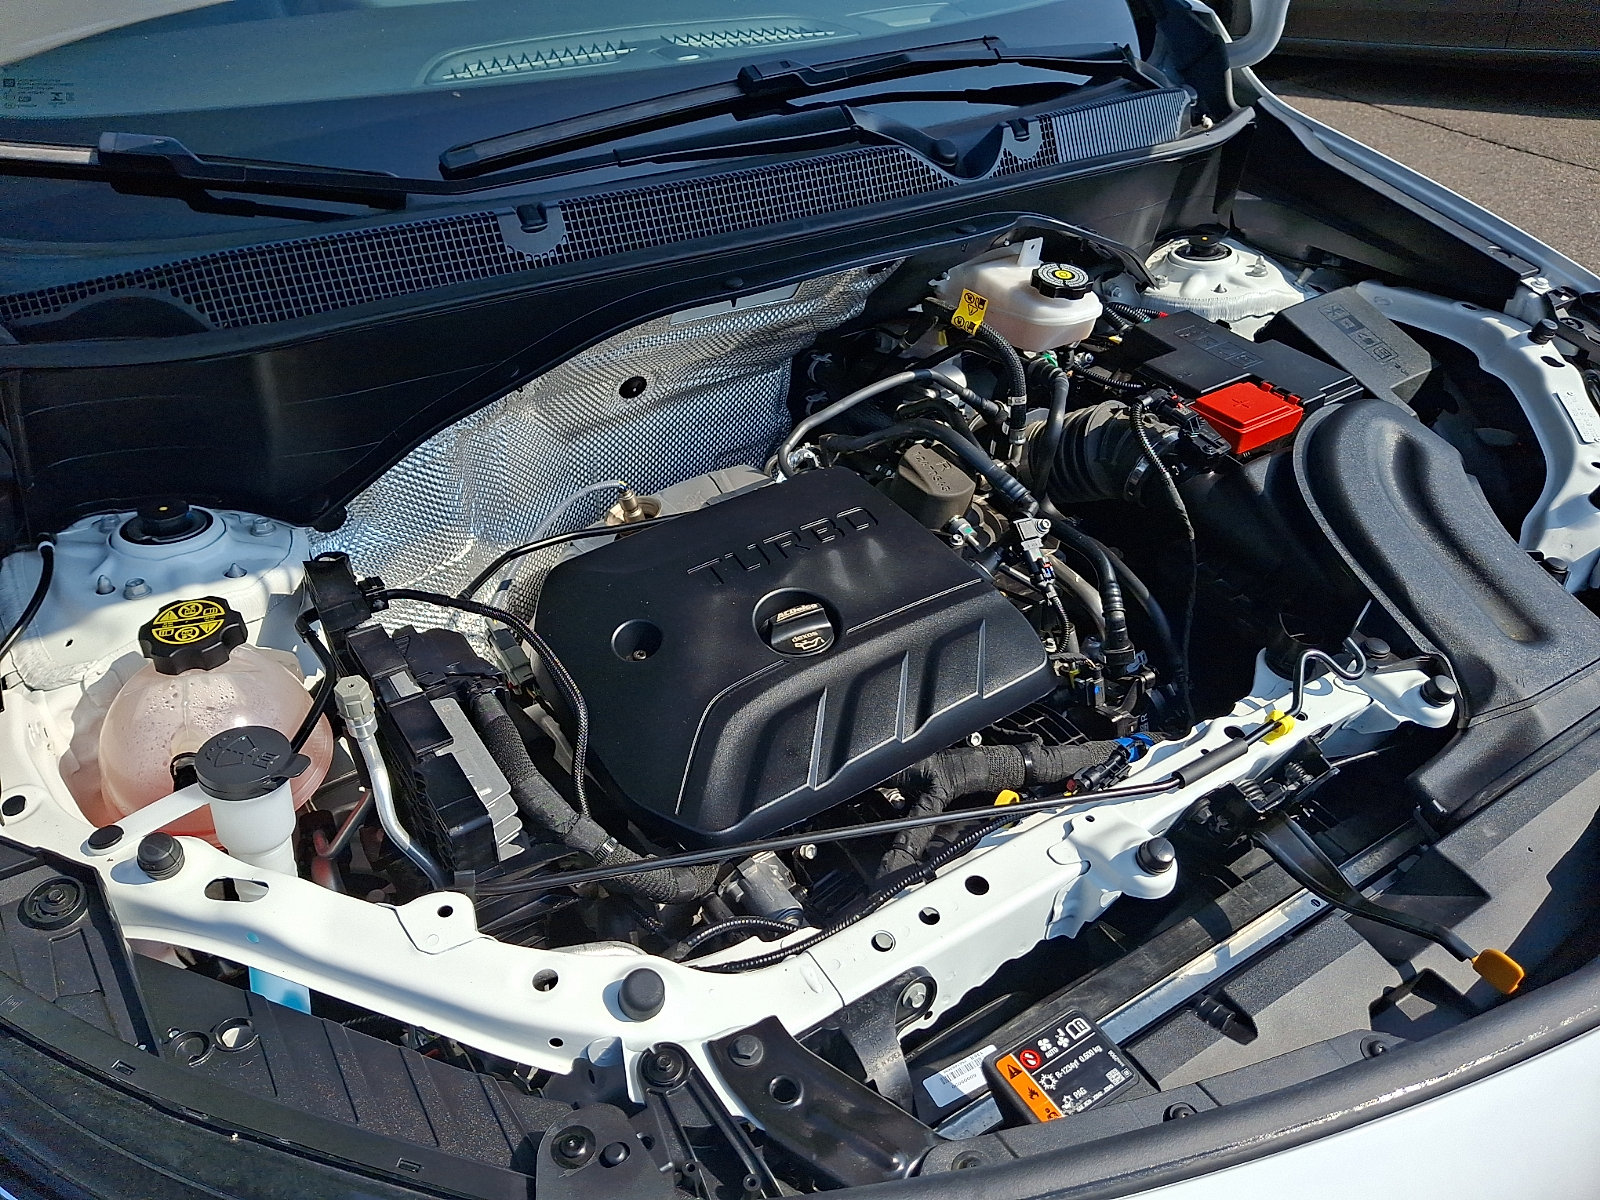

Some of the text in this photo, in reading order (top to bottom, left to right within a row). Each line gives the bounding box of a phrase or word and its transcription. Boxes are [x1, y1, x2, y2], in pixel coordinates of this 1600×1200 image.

[686, 506, 879, 585] TURBO
[776, 603, 818, 623] ACDelco
[791, 631, 819, 643] dexos
[1045, 1046, 1059, 1059] AUTO
[1054, 1059, 1080, 1080] R-1234yf
[1078, 1049, 1095, 1064] 0.600
[1094, 1045, 1103, 1055] kg
[1072, 1087, 1088, 1099] PAG
